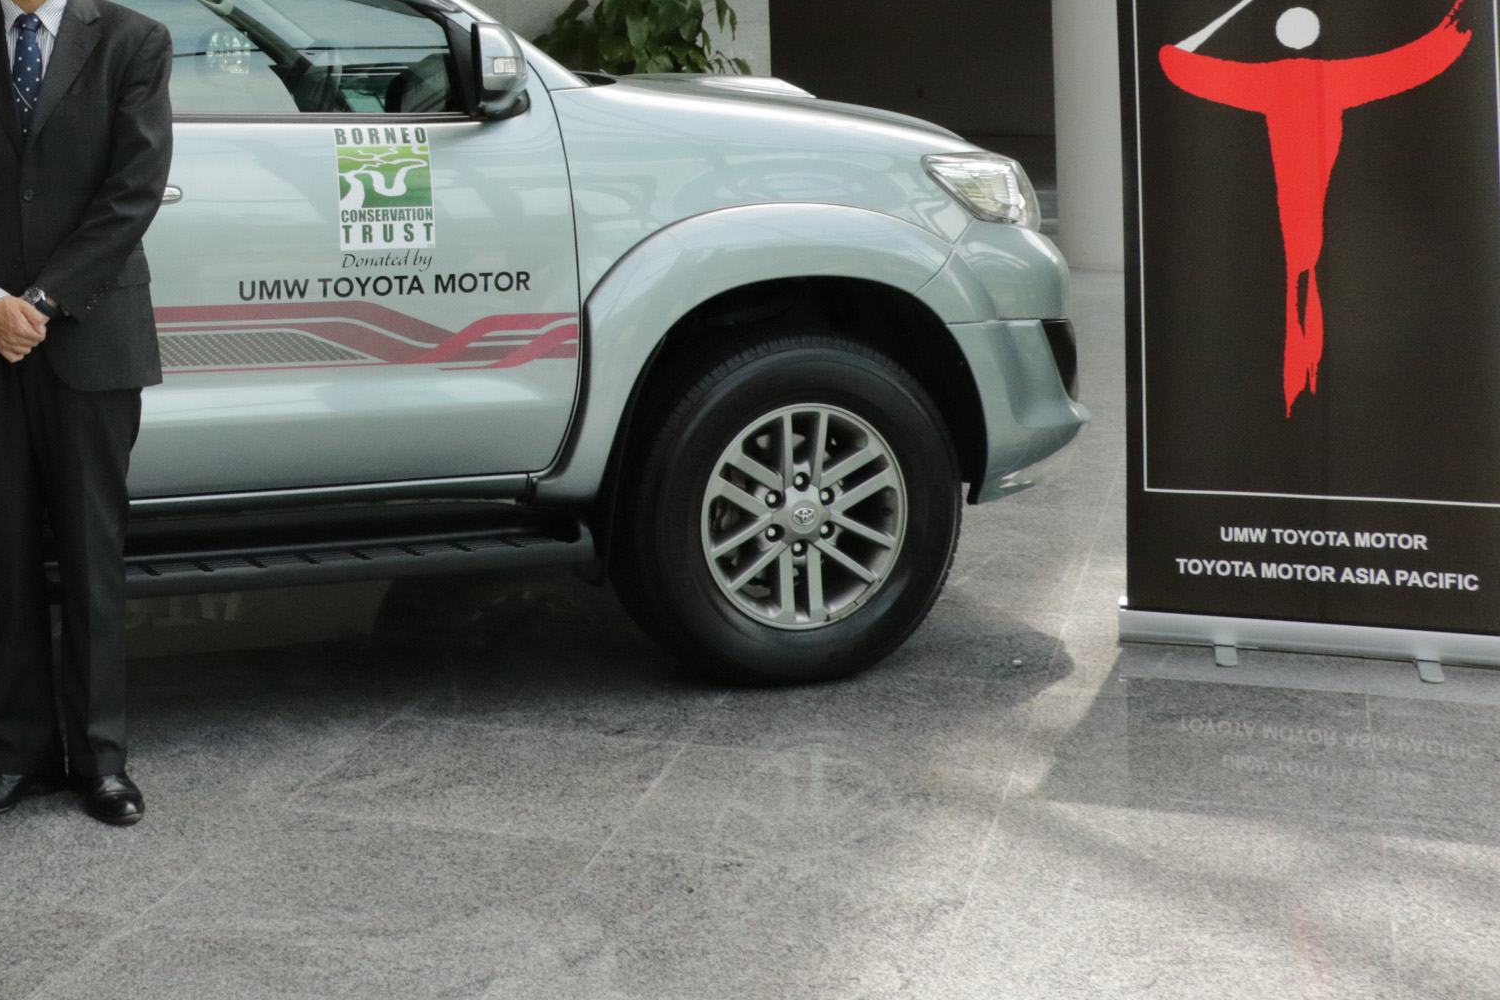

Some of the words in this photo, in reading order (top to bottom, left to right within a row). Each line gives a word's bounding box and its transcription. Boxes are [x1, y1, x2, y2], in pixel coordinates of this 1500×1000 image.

[334, 126, 427, 145] BORNEO
[341, 207, 433, 222] CONSERVATION
[342, 222, 433, 244] TRUST
[342, 248, 410, 269] Donated
[412, 248, 433, 272] by
[239, 278, 310, 302] UMW
[317, 274, 425, 298] TOYOTA
[434, 270, 531, 294] MOTOR
[1220, 526, 1267, 543] UMW
[1271, 528, 1350, 547] TOYOTA
[1354, 531, 1428, 551] MOTOR
[1176, 558, 1257, 578] TOYOTA
[1260, 562, 1336, 583] MOTOR
[1340, 566, 1391, 586] ASIA
[1395, 569, 1479, 592] PACIFIC
